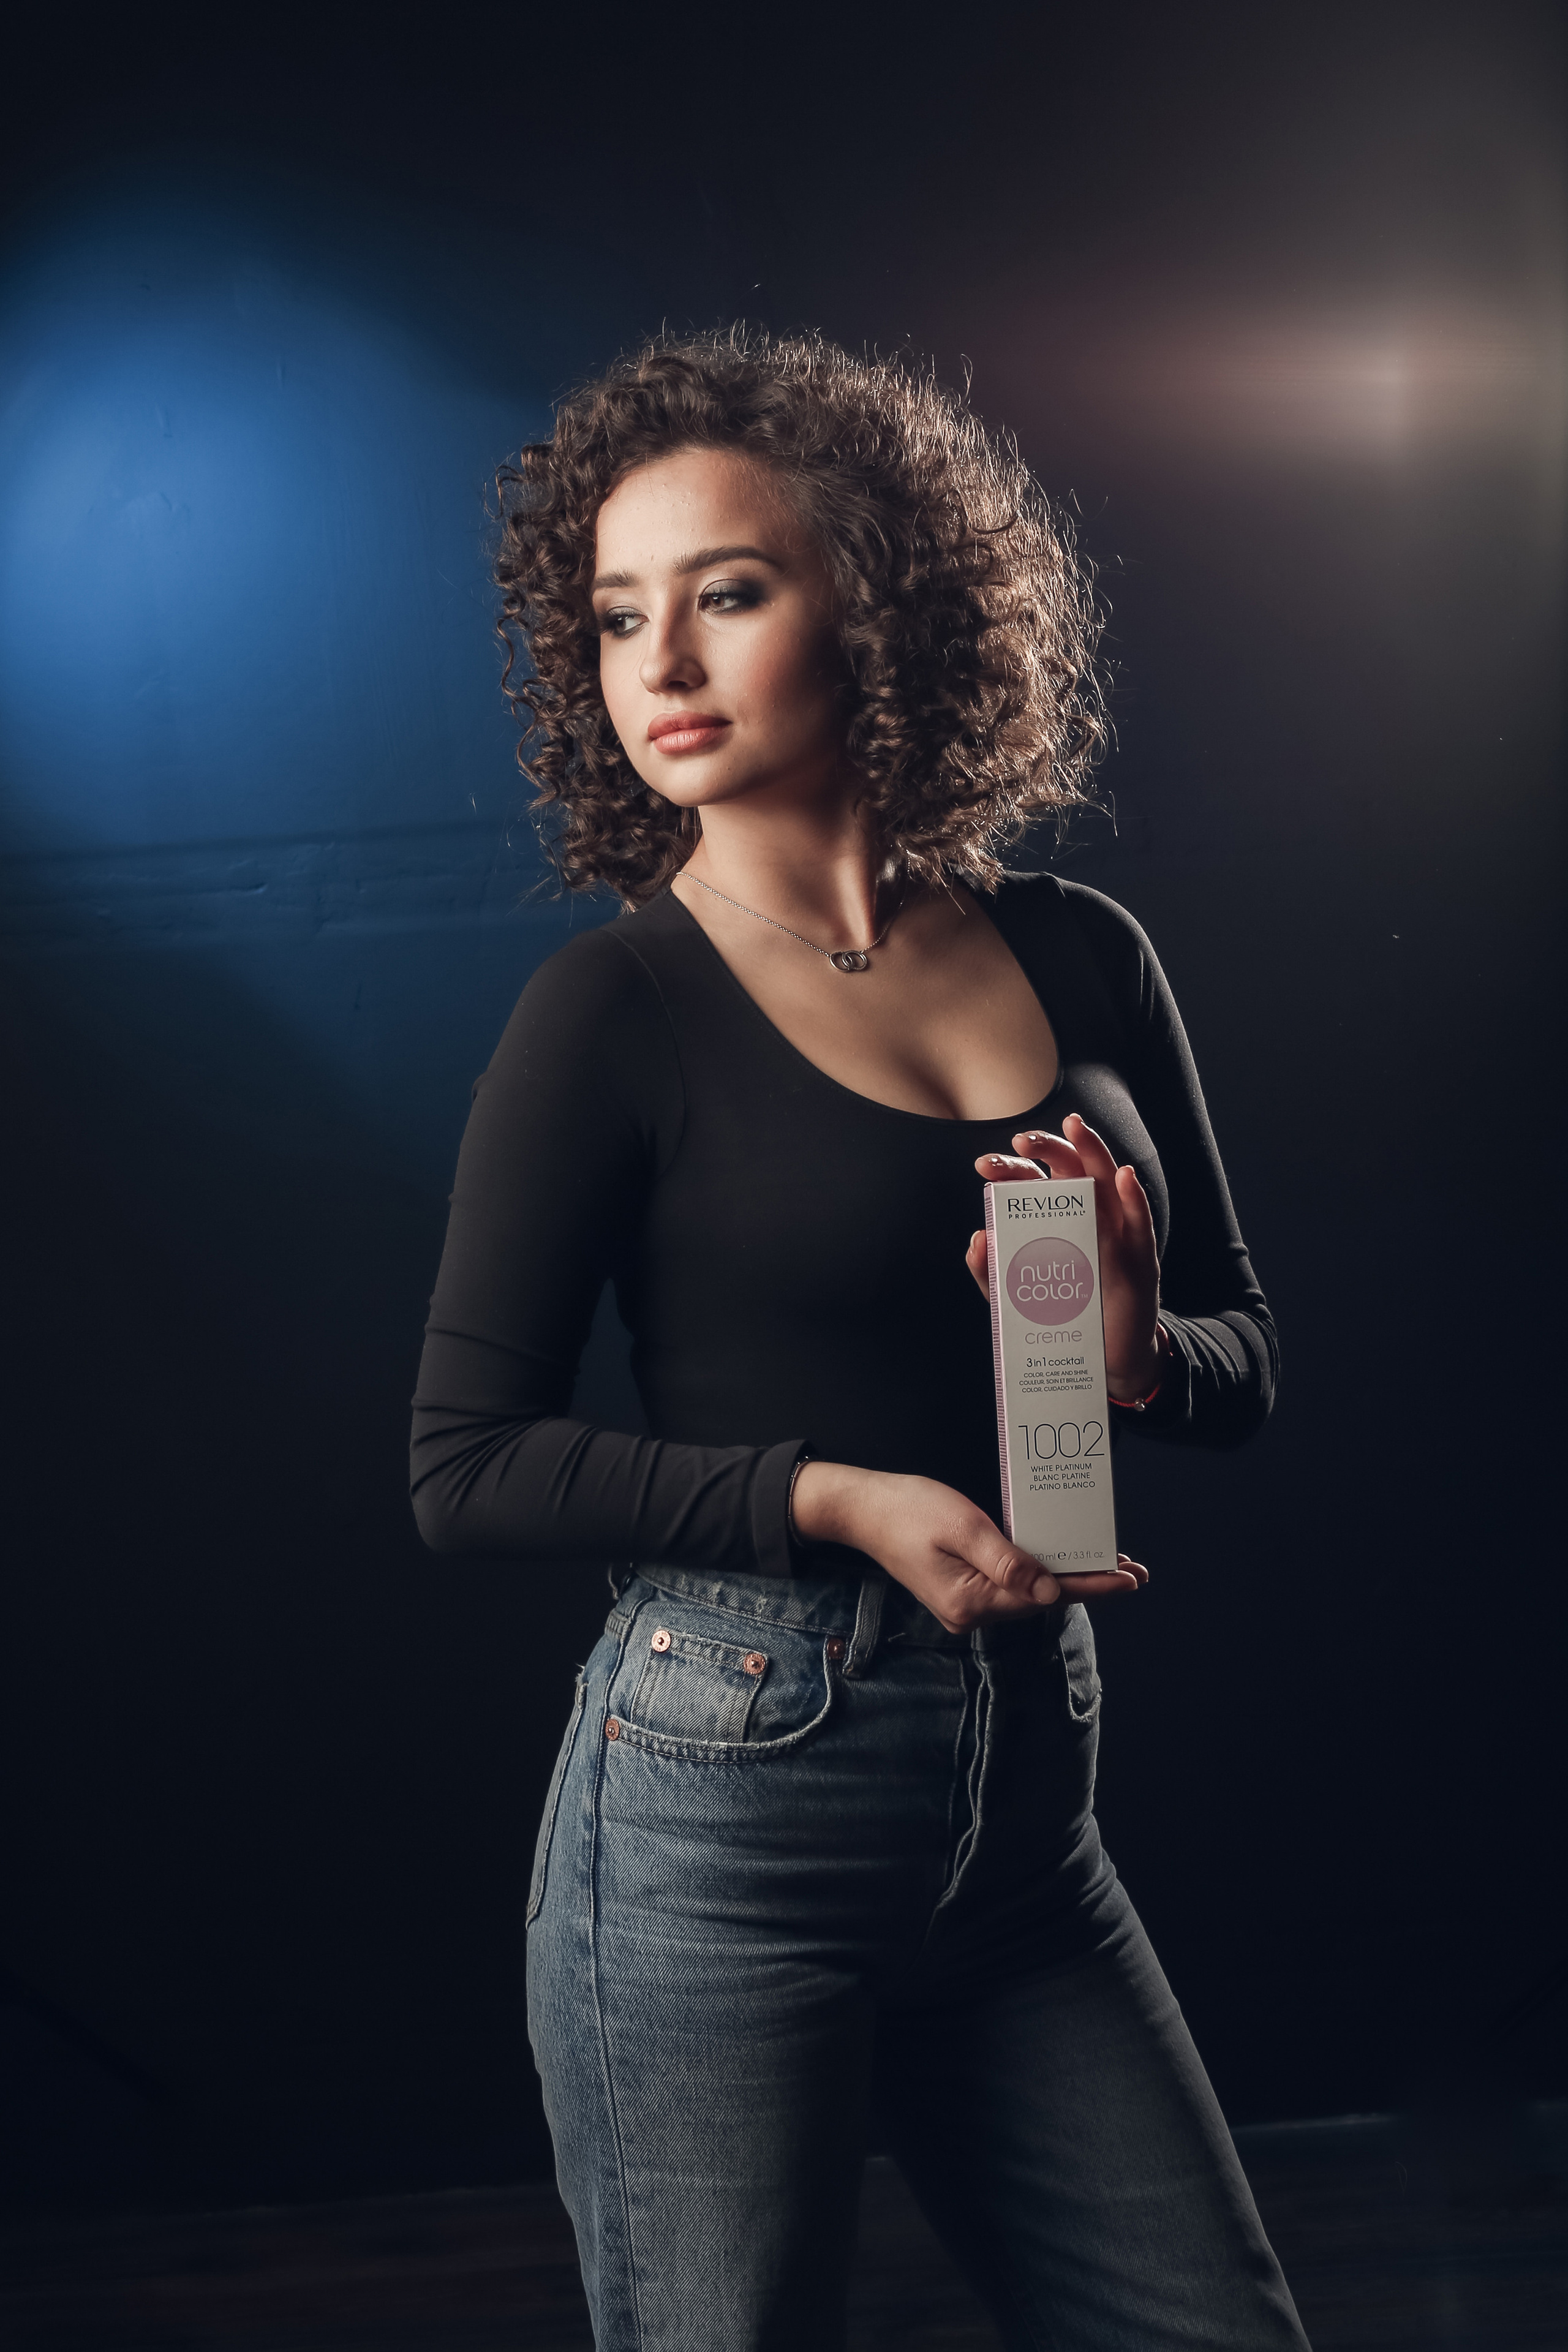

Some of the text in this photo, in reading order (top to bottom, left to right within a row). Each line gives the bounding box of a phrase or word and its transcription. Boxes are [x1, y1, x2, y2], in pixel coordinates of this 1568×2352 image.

[1007, 1195, 1084, 1212] REVLON
[1020, 1260, 1075, 1283] nutri
[1016, 1282, 1084, 1302] color
[1025, 1330, 1083, 1344] creme
[1026, 1356, 1084, 1367] 3 in 1 cocktail
[1018, 1421, 1105, 1460] 1002
[1055, 1463, 1092, 1471] PLATINUM
[1063, 1481, 1095, 1490] BLANCO
